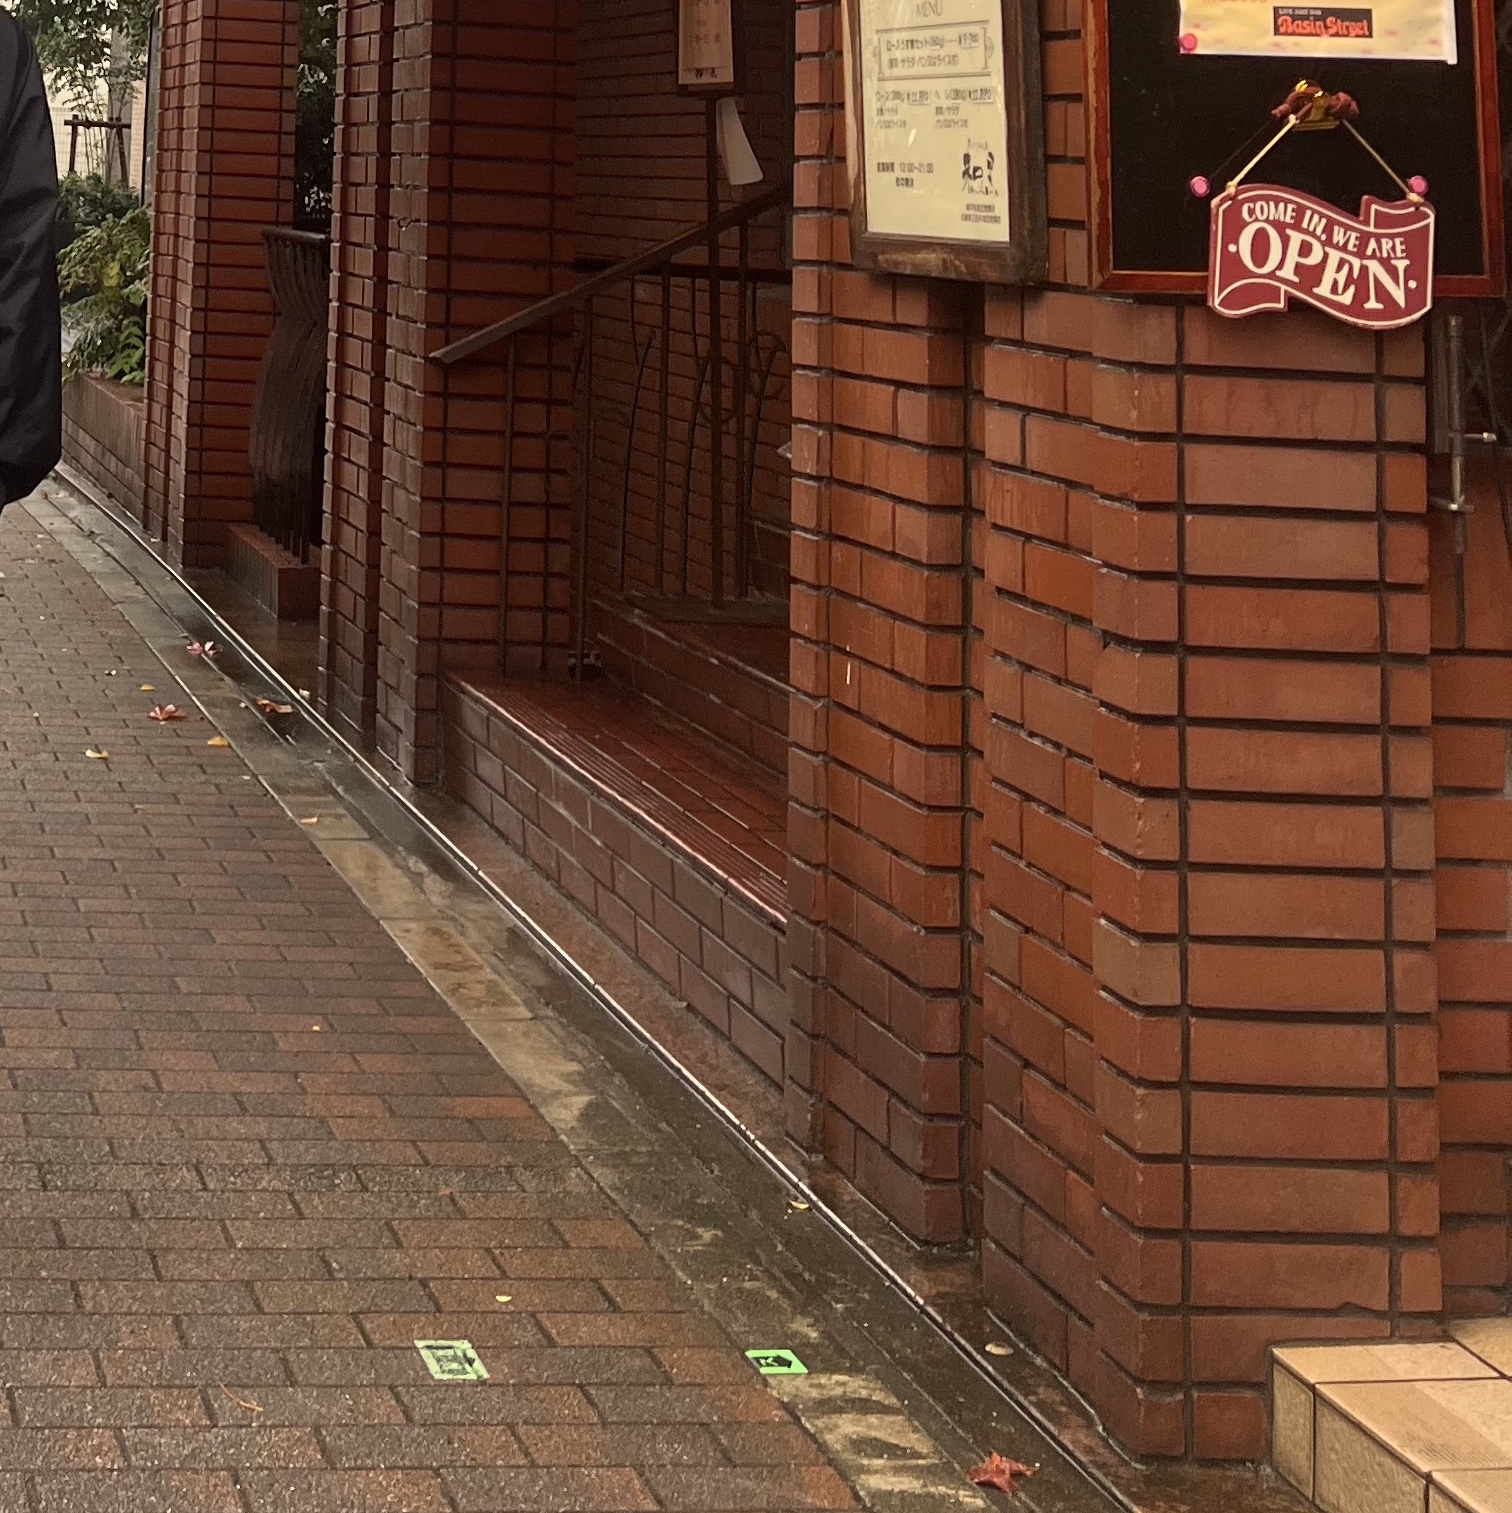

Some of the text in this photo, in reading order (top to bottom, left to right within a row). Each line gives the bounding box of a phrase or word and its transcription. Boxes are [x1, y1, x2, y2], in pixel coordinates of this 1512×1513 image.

[915, 0, 944, 18] MENU
[1277, 16, 1369, 37] Basin Street
[1241, 199, 1407, 258] COME IN, WE ARE
[1238, 221, 1411, 310] OPEN
